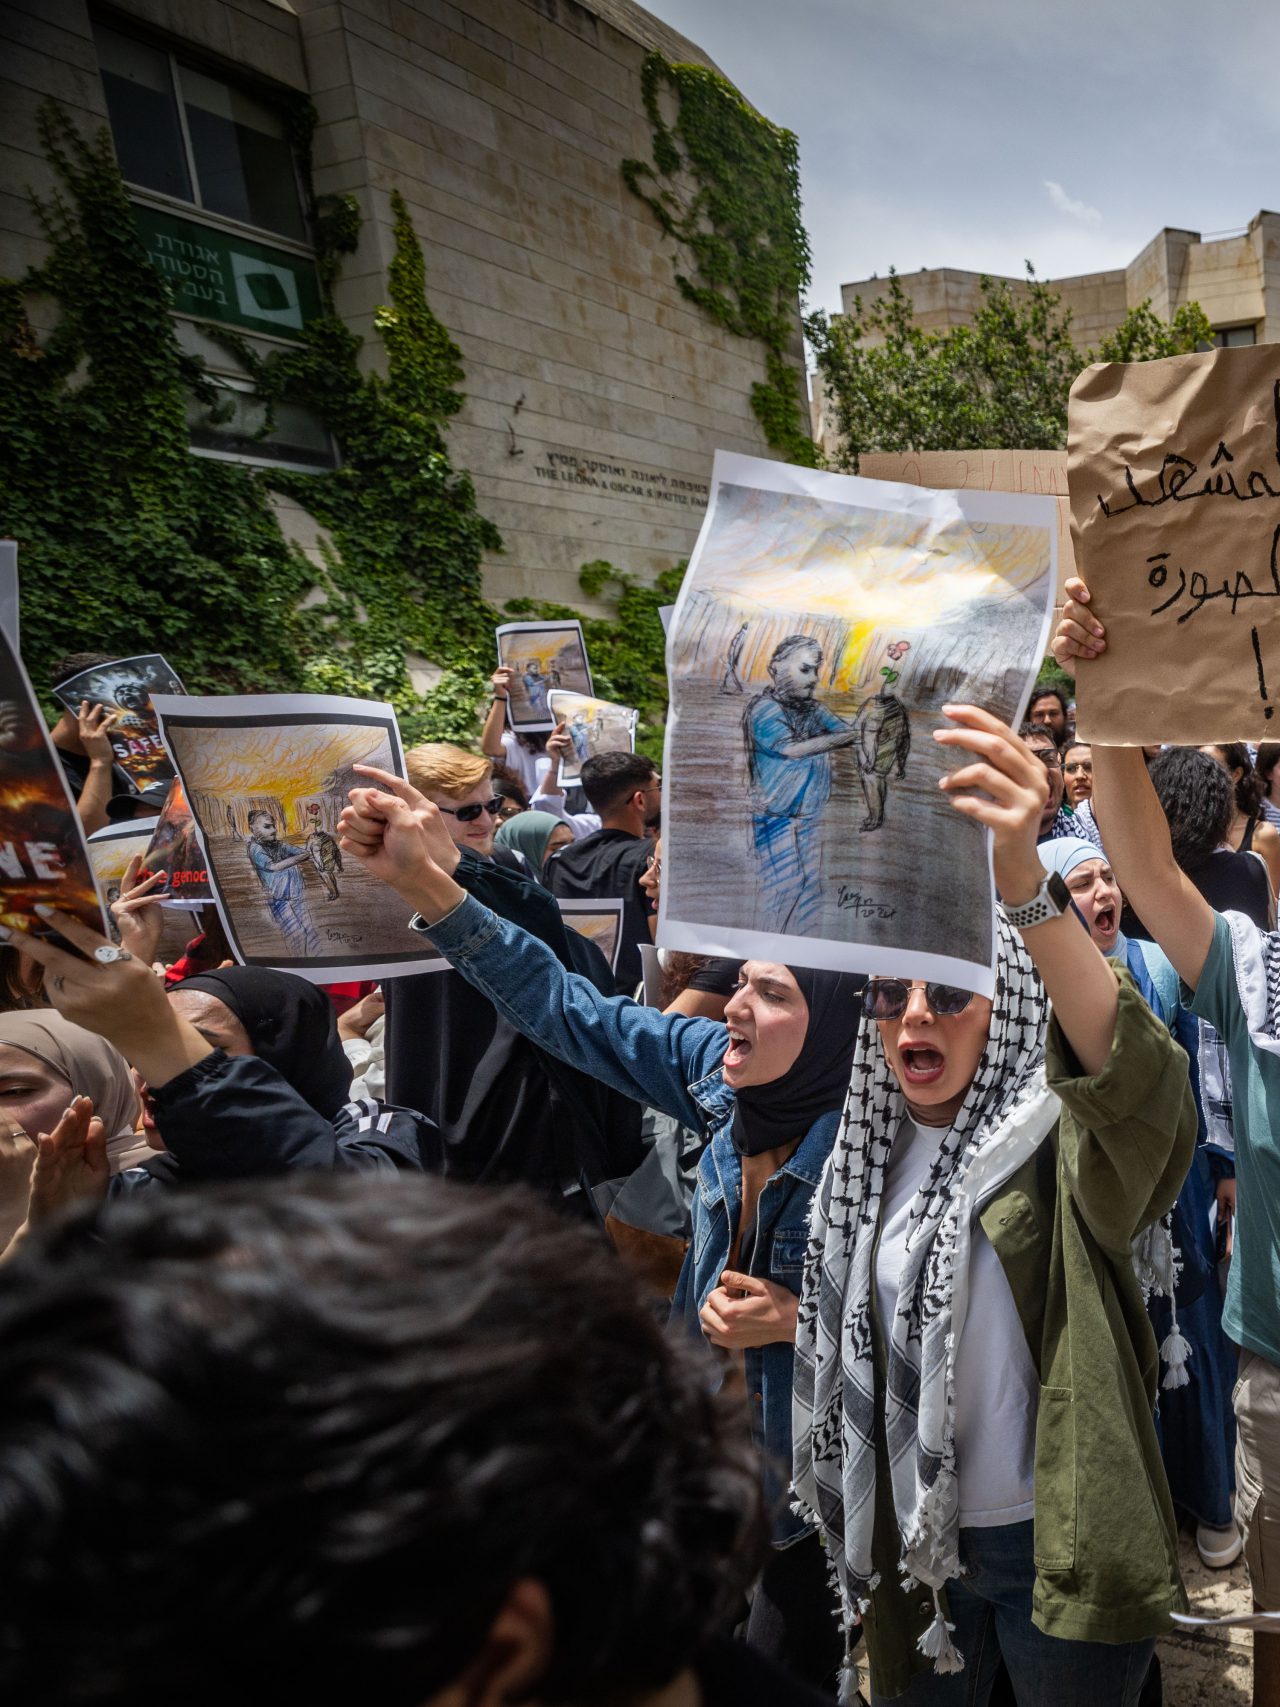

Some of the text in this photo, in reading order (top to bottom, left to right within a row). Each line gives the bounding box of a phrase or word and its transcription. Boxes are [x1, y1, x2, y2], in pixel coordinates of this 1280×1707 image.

[155, 233, 220, 265] אגודת
[534, 466, 559, 481] THE
[561, 470, 599, 489] LEONA
[609, 481, 643, 496] OSCAR
[112, 733, 164, 760] SAFE
[0, 841, 67, 879] NE
[172, 870, 209, 888] genoc
